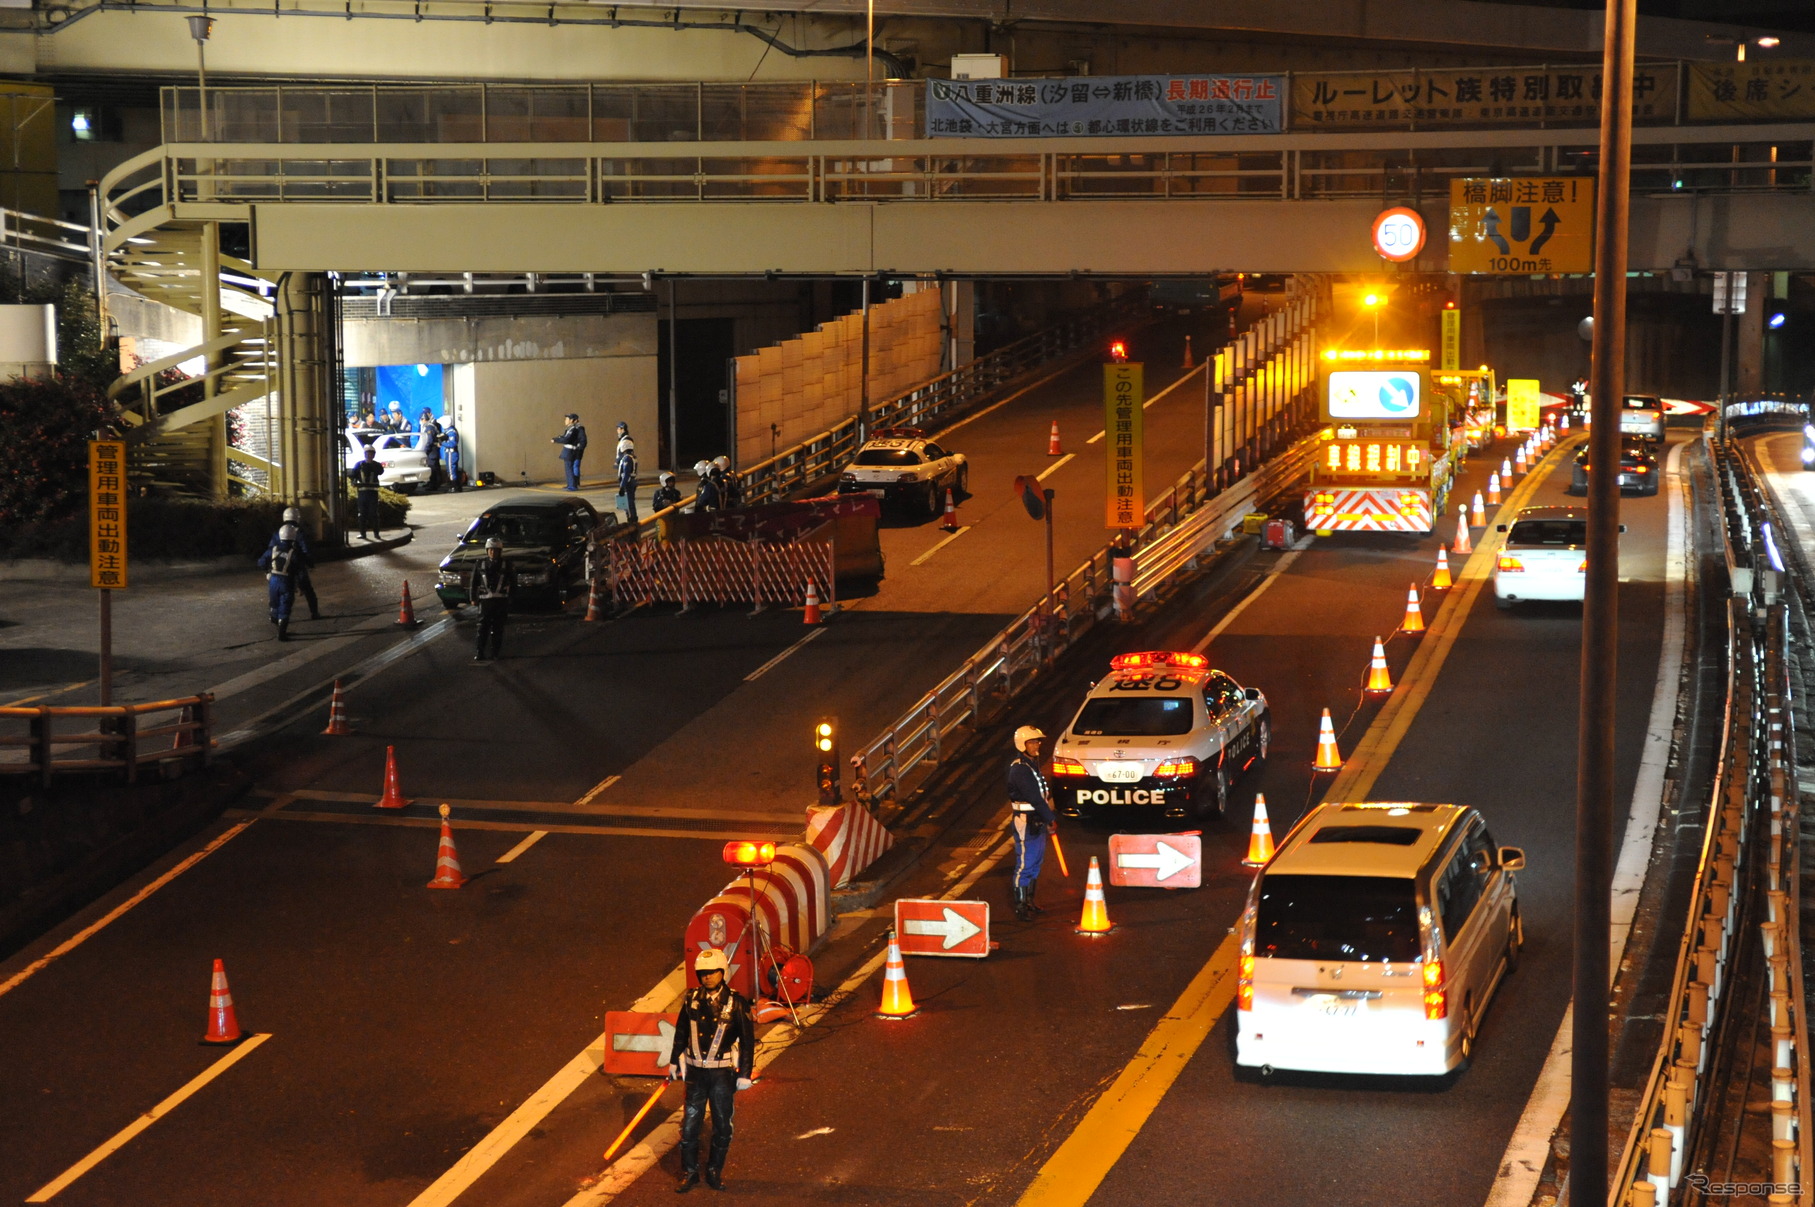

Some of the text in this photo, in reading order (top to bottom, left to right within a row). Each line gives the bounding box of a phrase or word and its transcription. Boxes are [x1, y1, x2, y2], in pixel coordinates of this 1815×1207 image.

[1166, 79, 1276, 101] 長期通行止
[1463, 180, 1577, 204] 橋脚注意!
[1384, 223, 1413, 247] 50
[1488, 257, 1553, 272] 100m先
[1115, 367, 1134, 524] この先管理用車両出動注意
[96, 444, 121, 585] 管理用車両出動注意
[1228, 730, 1250, 759] POLICE
[1112, 770, 1136, 779] 67-00
[1077, 789, 1165, 805] POLICE
